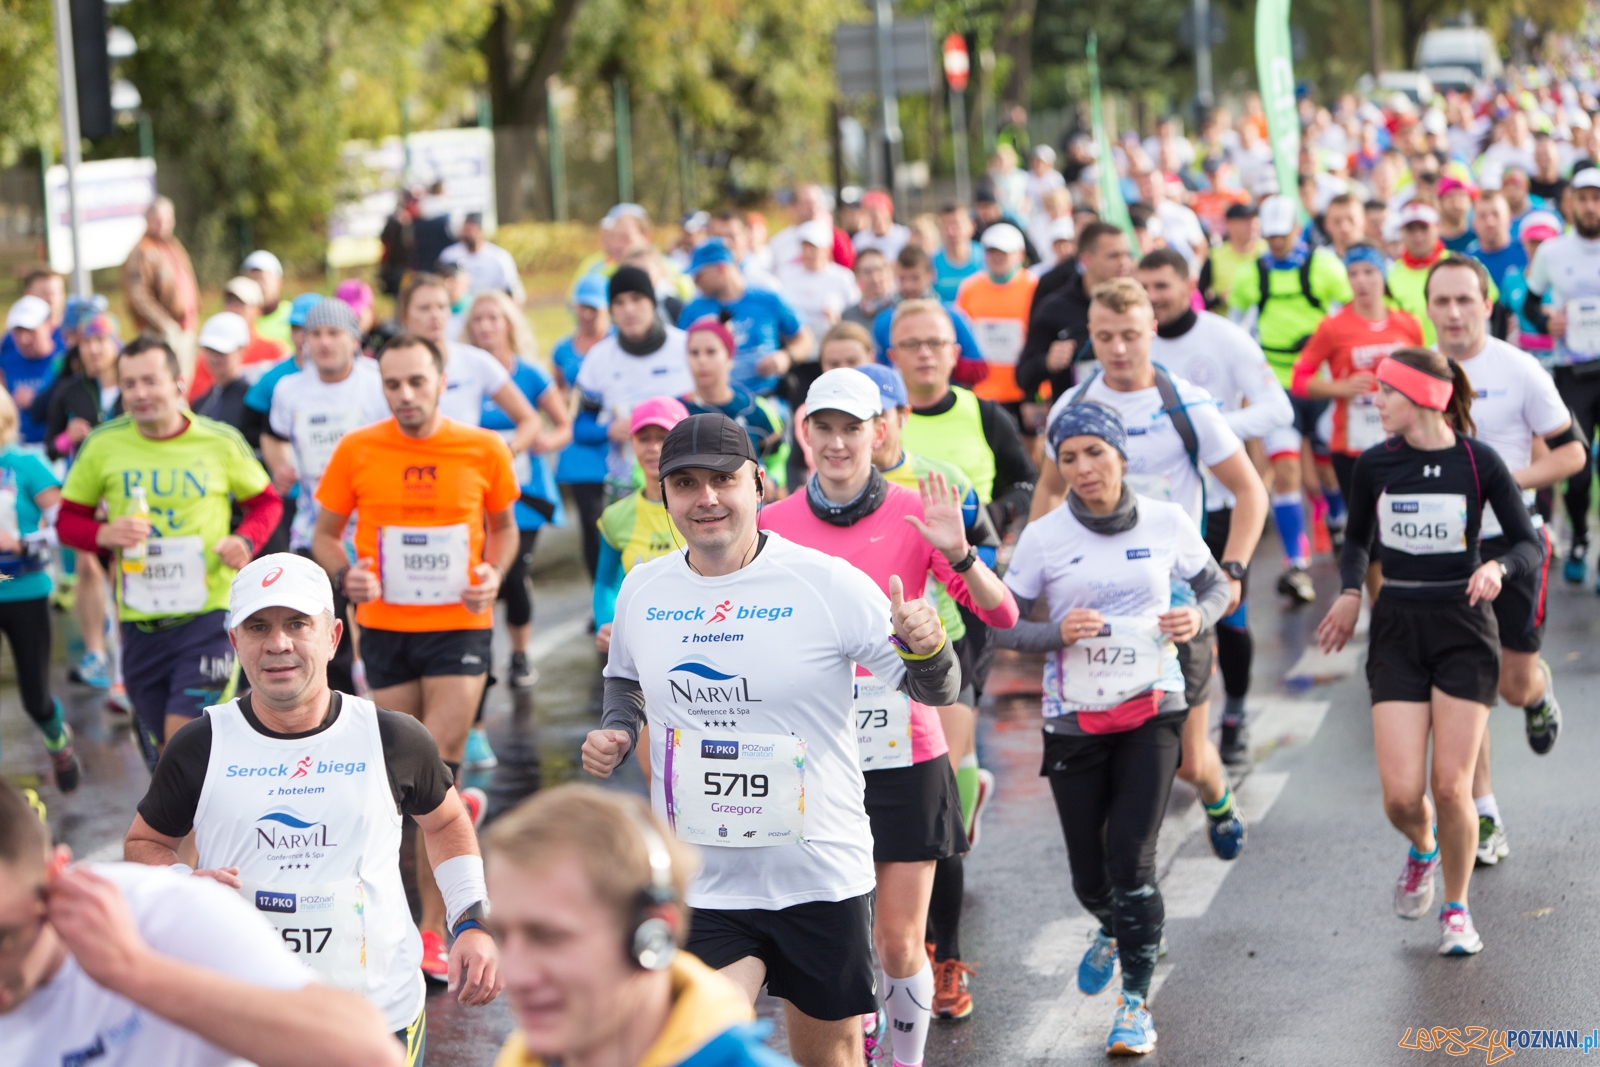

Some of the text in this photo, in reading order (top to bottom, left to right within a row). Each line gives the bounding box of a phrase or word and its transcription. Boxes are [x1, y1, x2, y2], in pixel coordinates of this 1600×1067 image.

[122, 469, 209, 498] RUN
[1391, 521, 1448, 539] 4046
[403, 553, 450, 571] 1899
[142, 562, 184, 580] 4871
[646, 605, 793, 621] Serock biega
[692, 632, 744, 643] hotelem
[1084, 647, 1137, 666] 1473
[688, 708, 727, 716] Conference
[855, 709, 888, 729] 73
[857, 735, 872, 744] ata
[742, 750, 773, 758] maraton
[226, 760, 366, 778] Serock biega
[278, 786, 325, 796] hotelem
[704, 771, 769, 798] 5719
[711, 802, 763, 816] Grzegorz
[267, 852, 303, 861] Conference
[312, 852, 324, 860] Spa
[300, 902, 335, 910] maraton
[276, 927, 332, 954] 517
